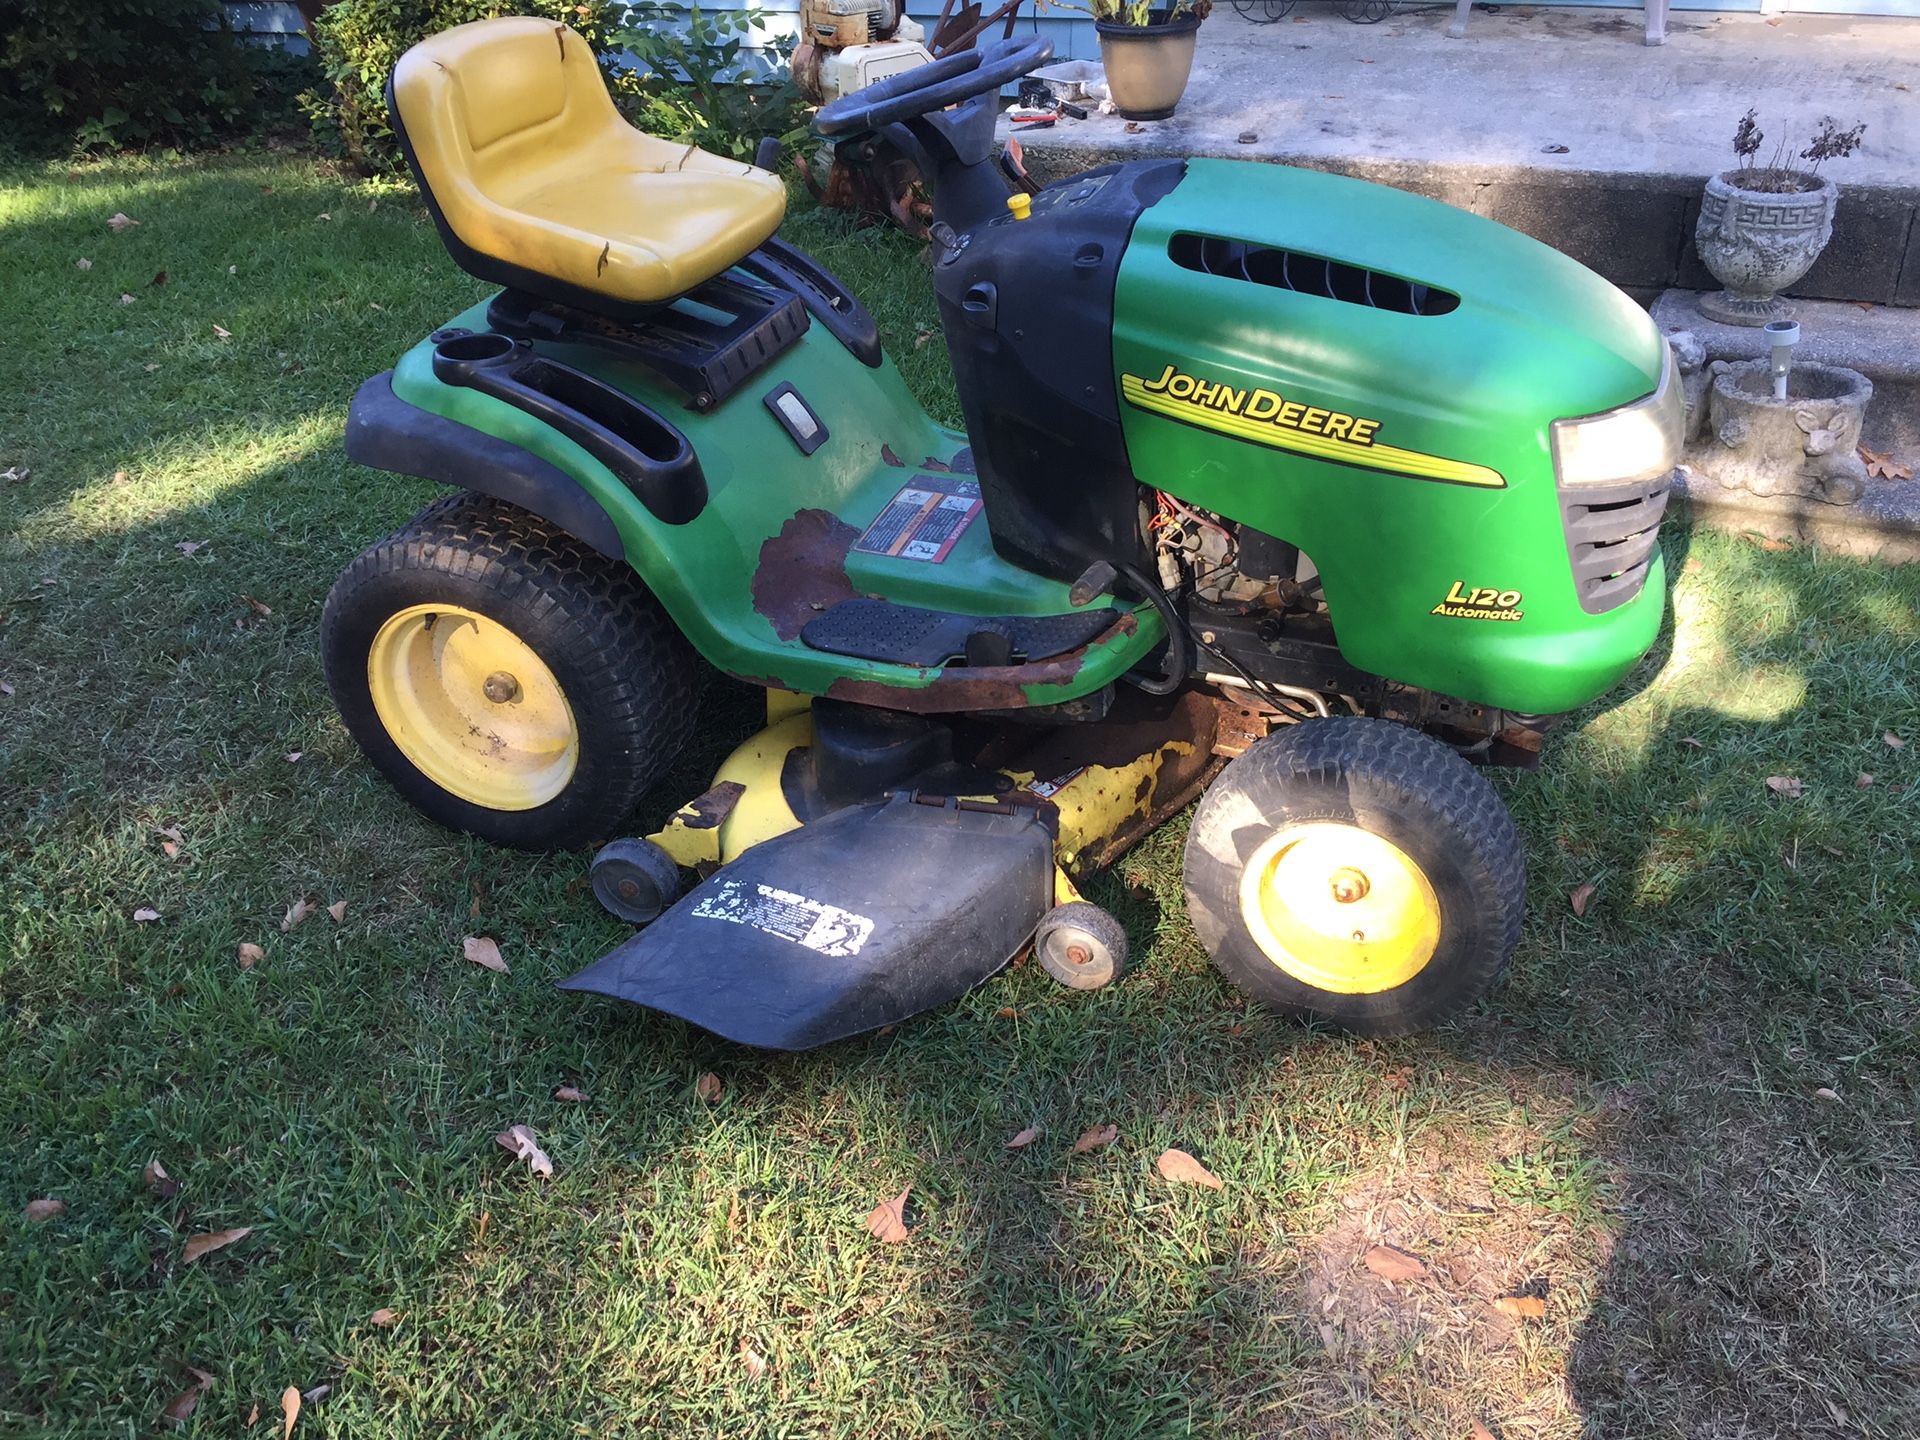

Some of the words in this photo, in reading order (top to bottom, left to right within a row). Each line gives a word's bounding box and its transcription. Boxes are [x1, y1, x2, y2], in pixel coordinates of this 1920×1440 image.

[1143, 365, 1246, 414] JOHN
[1244, 388, 1382, 446] DEERE
[1445, 581, 1522, 608] L120
[1431, 603, 1524, 621] Automatic
